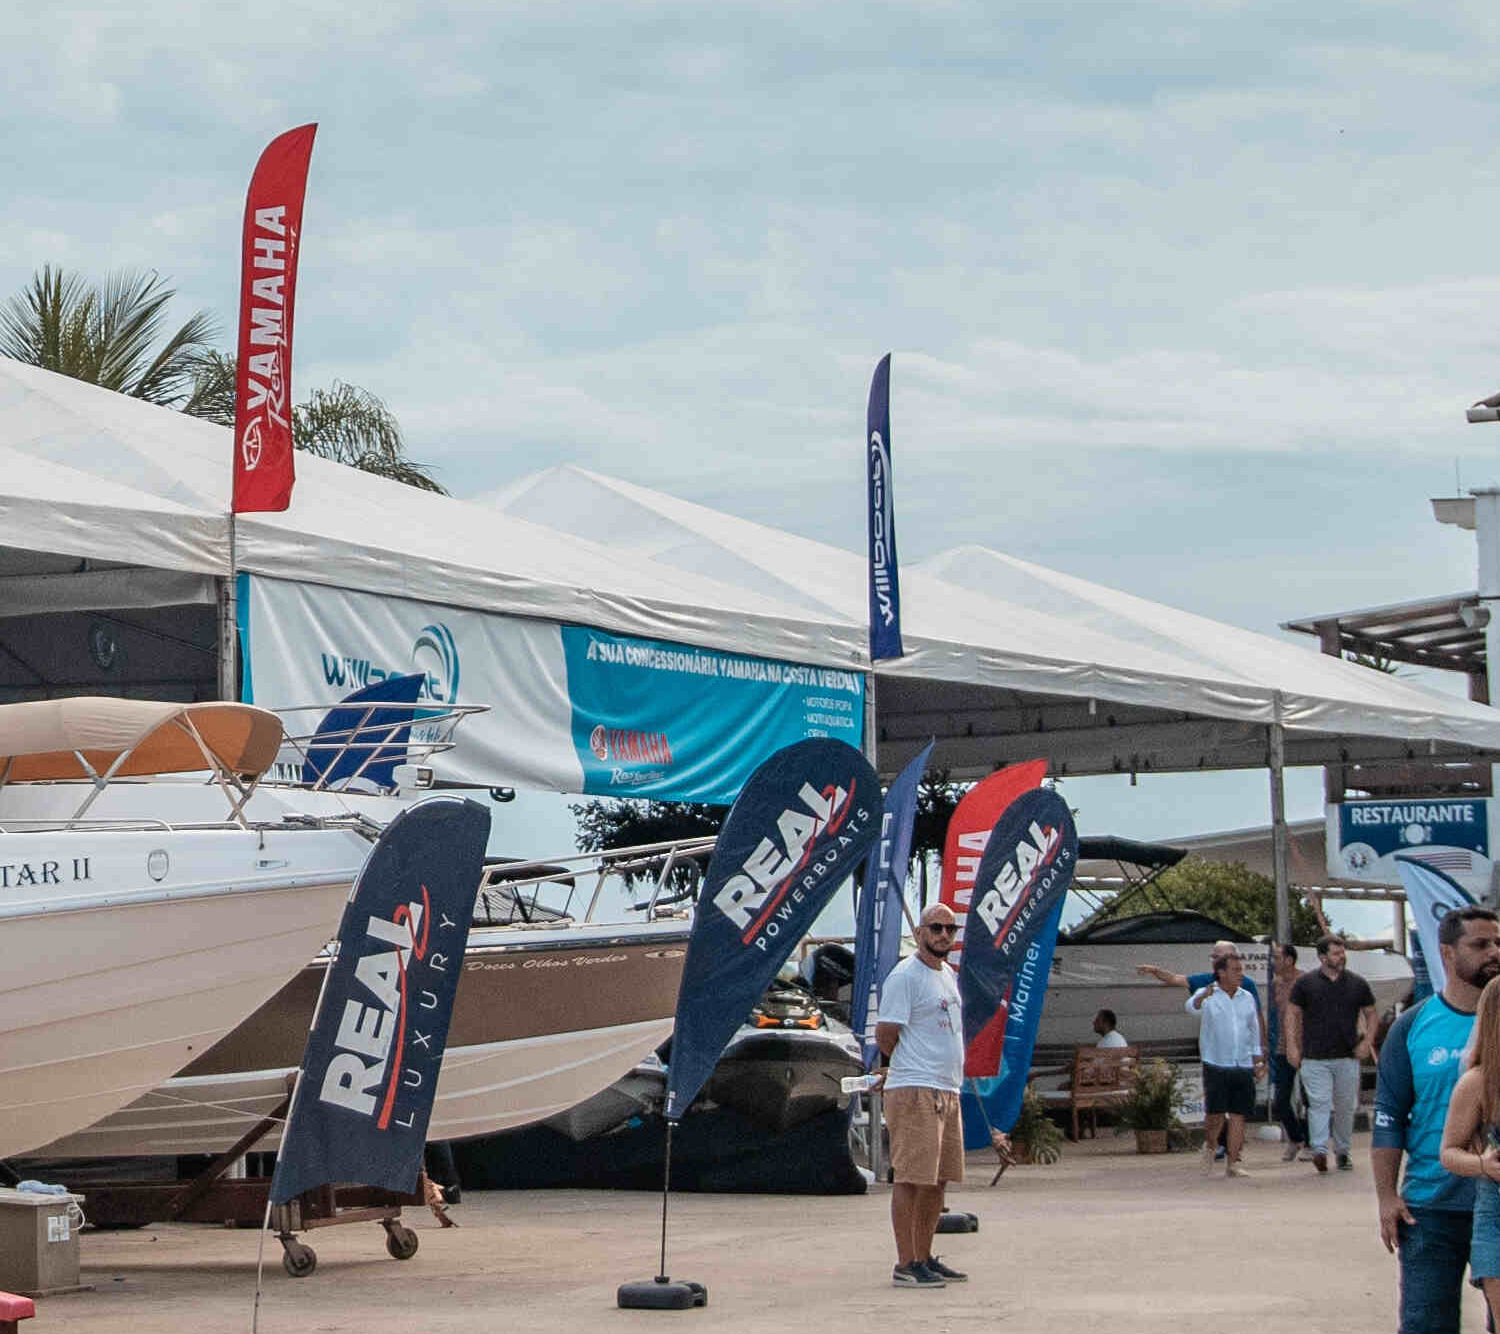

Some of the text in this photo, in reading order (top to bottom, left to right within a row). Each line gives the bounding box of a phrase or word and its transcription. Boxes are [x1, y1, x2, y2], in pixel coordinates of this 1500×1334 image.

[247, 205, 286, 410] YAMAHA
[586, 640, 597, 660] A
[599, 643, 624, 664] SUA
[625, 645, 719, 676] CONCESSIONÁRIA
[719, 657, 767, 682] YAMAHA
[767, 664, 781, 683] NA
[610, 730, 673, 763] YAMAHA
[72, 857, 91, 882] II
[713, 781, 848, 931] REAL
[1351, 804, 1475, 825] RESTAURANTE
[755, 808, 870, 952] POWERBOATS
[976, 820, 1058, 936] REAL
[1002, 847, 1071, 956] POWERBOATS
[320, 901, 424, 1116] REAL
[522, 958, 569, 970] Olhos
[572, 953, 629, 967] Verdes
[395, 913, 456, 1129] LUXURY
